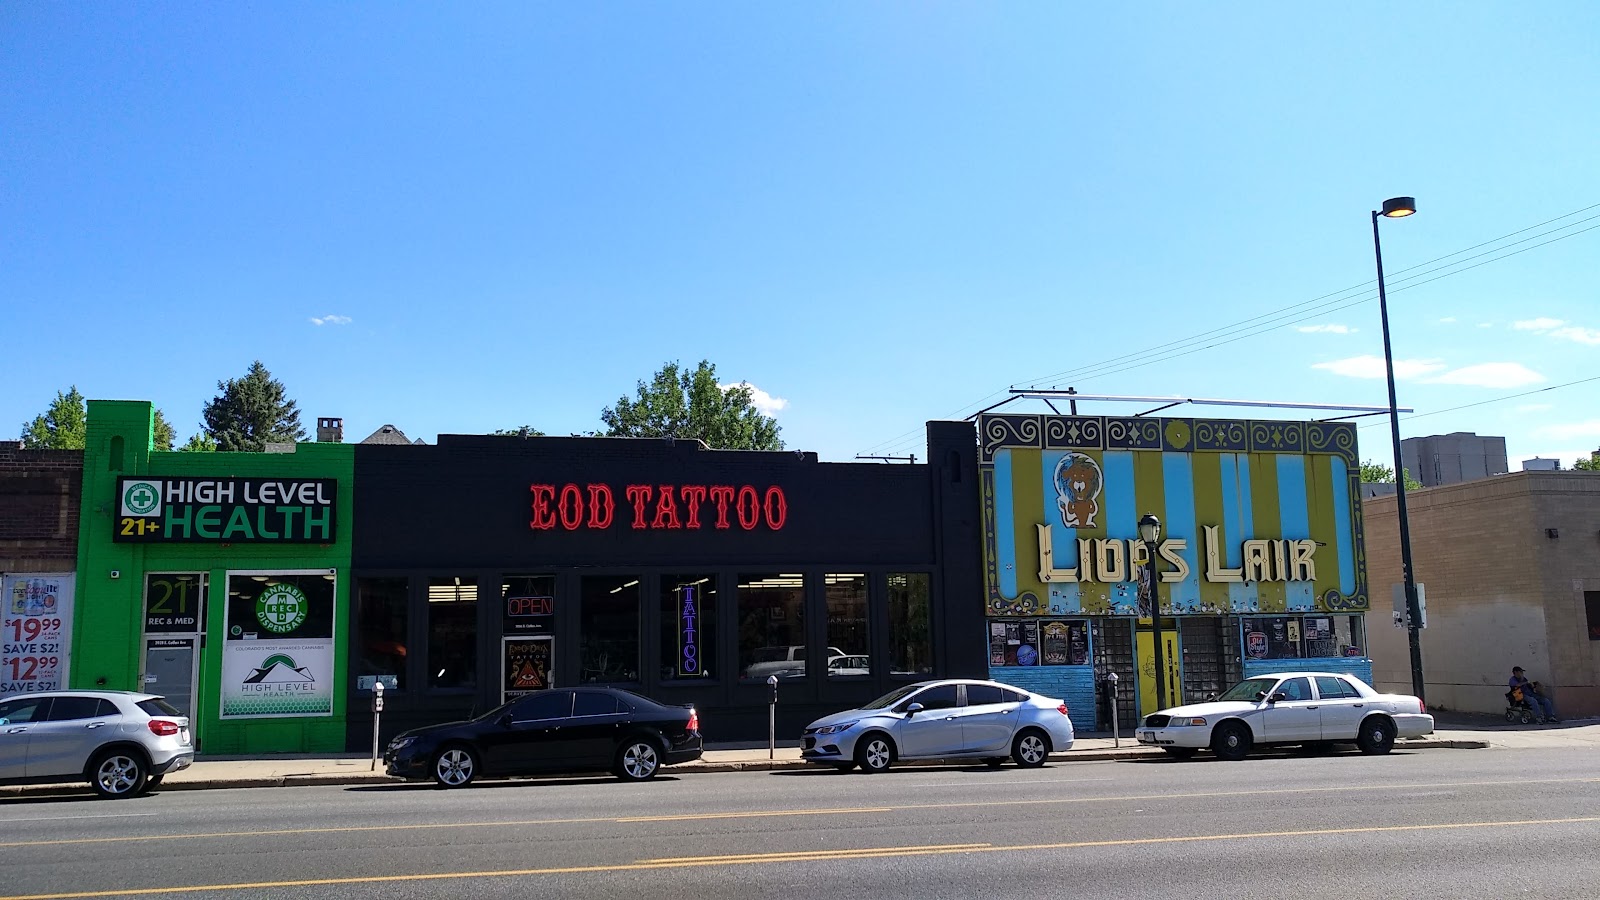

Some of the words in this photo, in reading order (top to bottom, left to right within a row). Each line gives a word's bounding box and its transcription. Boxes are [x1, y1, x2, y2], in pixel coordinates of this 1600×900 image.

[166, 480, 235, 503] HIGH
[243, 481, 331, 504] LEVEL
[530, 483, 615, 531] EOD
[626, 484, 787, 531] TATTOO
[120, 518, 160, 536] 21+
[163, 504, 331, 539] HEALTH
[149, 579, 196, 614] 21+
[259, 584, 305, 604] CANNABIS
[510, 598, 552, 615] OPEN
[148, 618, 165, 626] REC
[167, 617, 173, 625] &
[174, 617, 195, 625] MED
[257, 610, 306, 634] DISPENSARY
[683, 587, 696, 672] TATTOO
[3, 644, 37, 654] SAVE
[40, 643, 59, 653] $2!
[1250, 643, 1266, 653] Style
[1, 683, 35, 693] SAVE
[37, 682, 56, 691] $2!
[241, 684, 272, 692] HIGH
[278, 683, 316, 691] LEVEL
